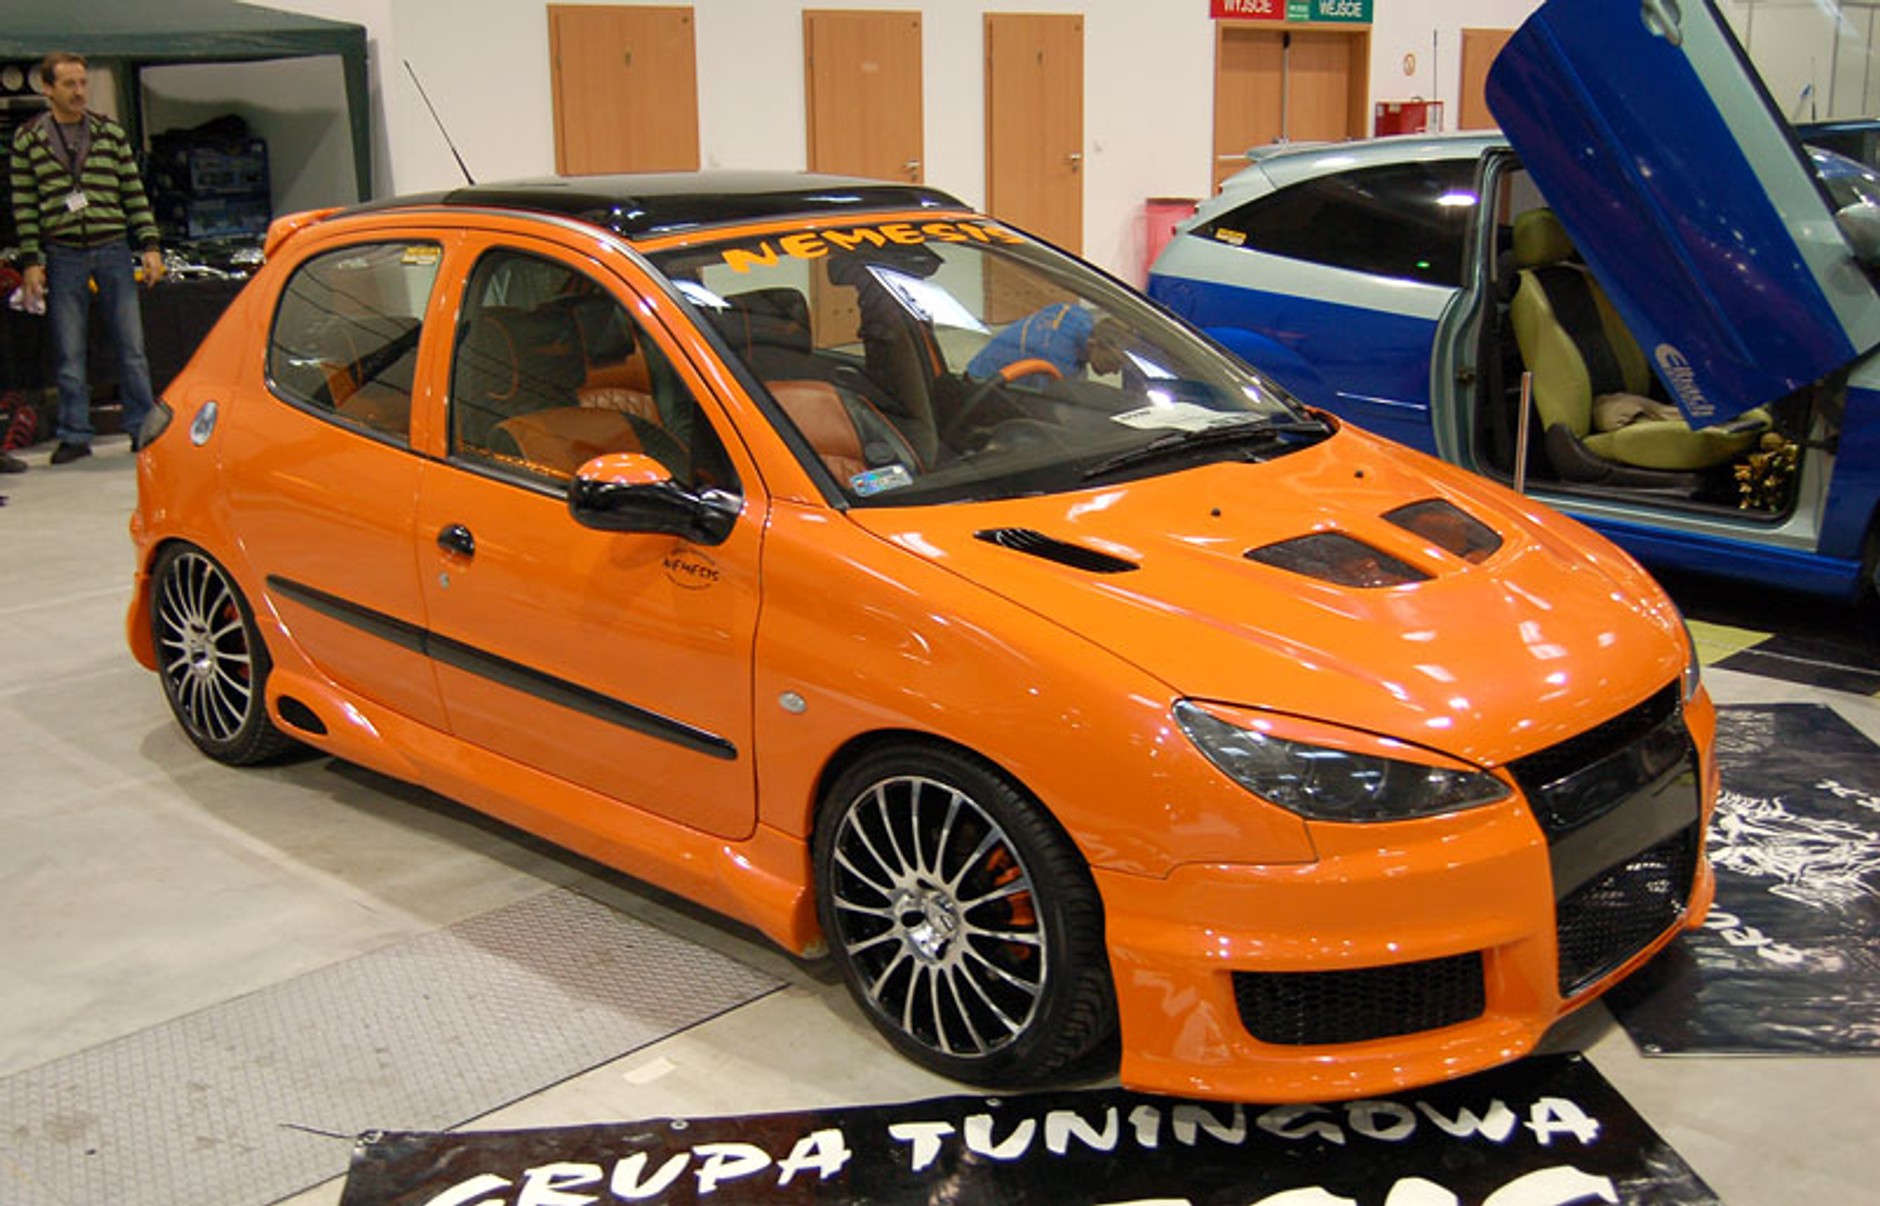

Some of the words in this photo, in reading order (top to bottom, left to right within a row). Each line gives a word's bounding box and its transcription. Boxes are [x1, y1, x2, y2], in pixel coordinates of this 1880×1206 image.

[721, 222, 1025, 274] NEMESIS
[424, 1128, 852, 1206] GRUPA
[888, 1097, 1600, 1171] TUNINGOWA
